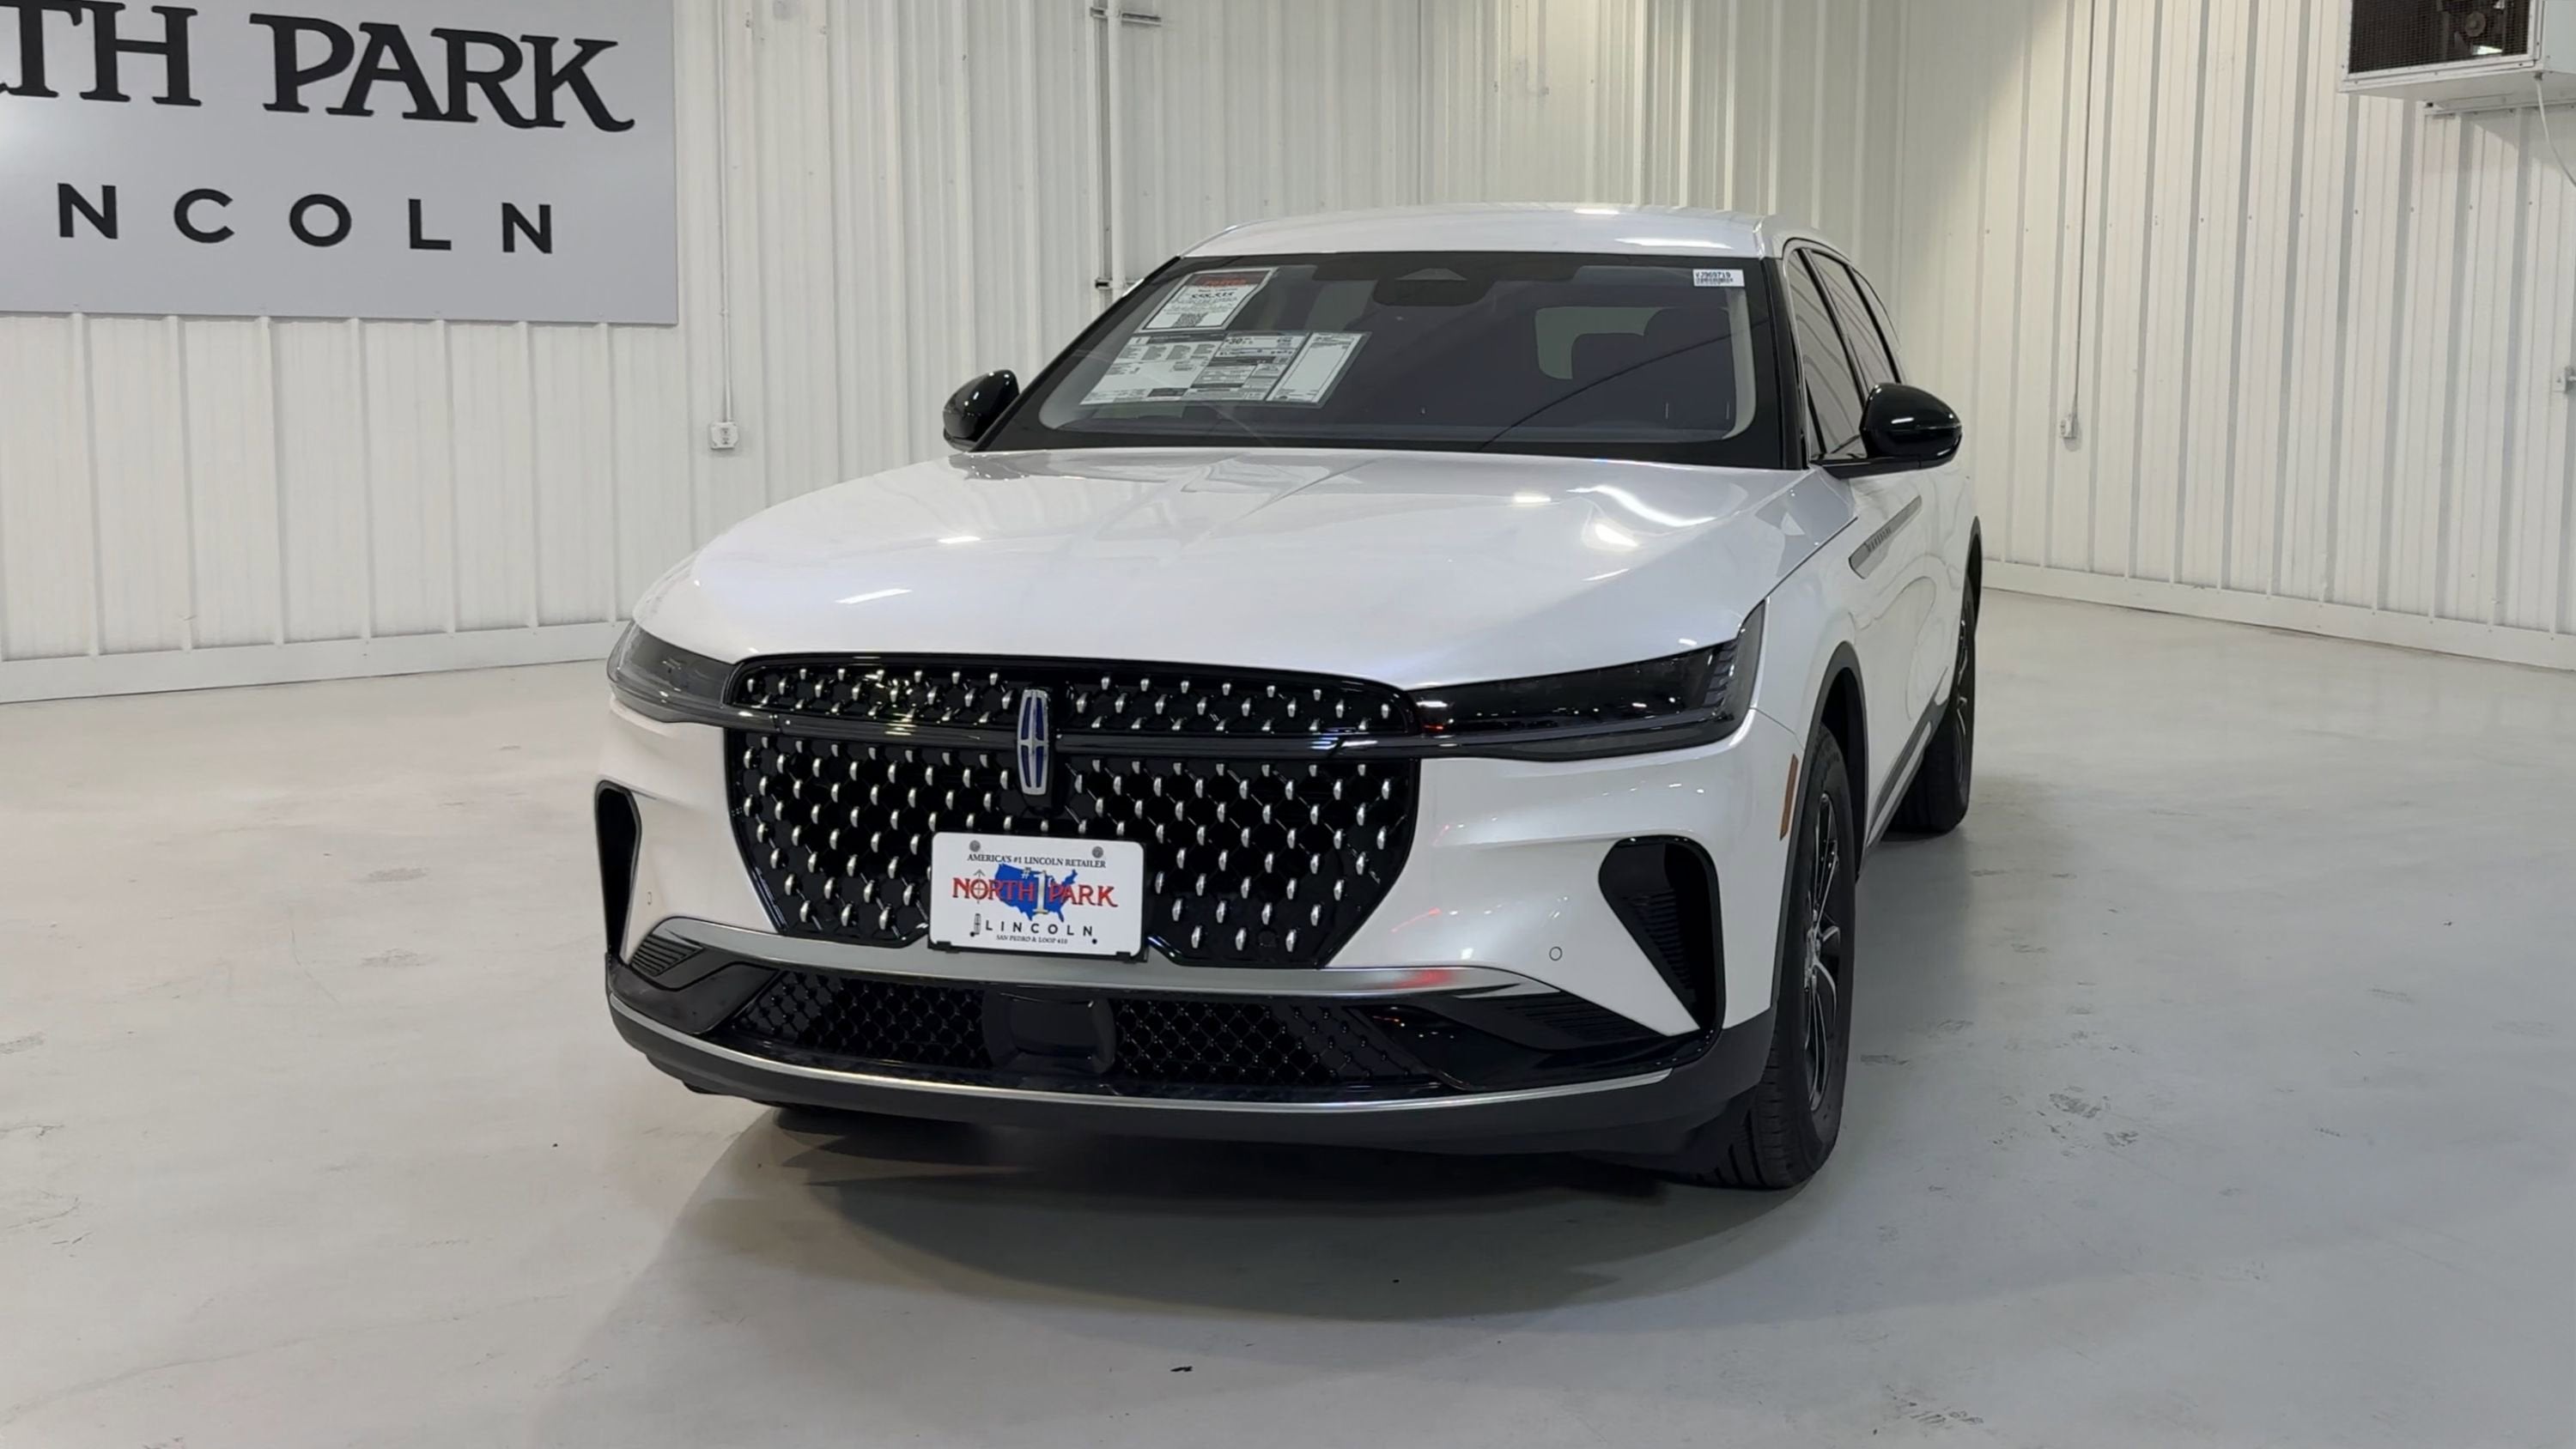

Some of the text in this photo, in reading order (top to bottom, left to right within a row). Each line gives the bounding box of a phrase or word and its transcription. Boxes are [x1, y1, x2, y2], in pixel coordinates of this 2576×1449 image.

[0, 0, 635, 132] TH PARK
[58, 182, 553, 254] NCOLN
[967, 853, 1012, 864] AMERICA'S
[1024, 857, 1063, 866] LINCOLN
[1065, 858, 1106, 868] RETAILER
[952, 877, 1118, 907] NORTH PARK
[986, 919, 1093, 937] LINCOLN
